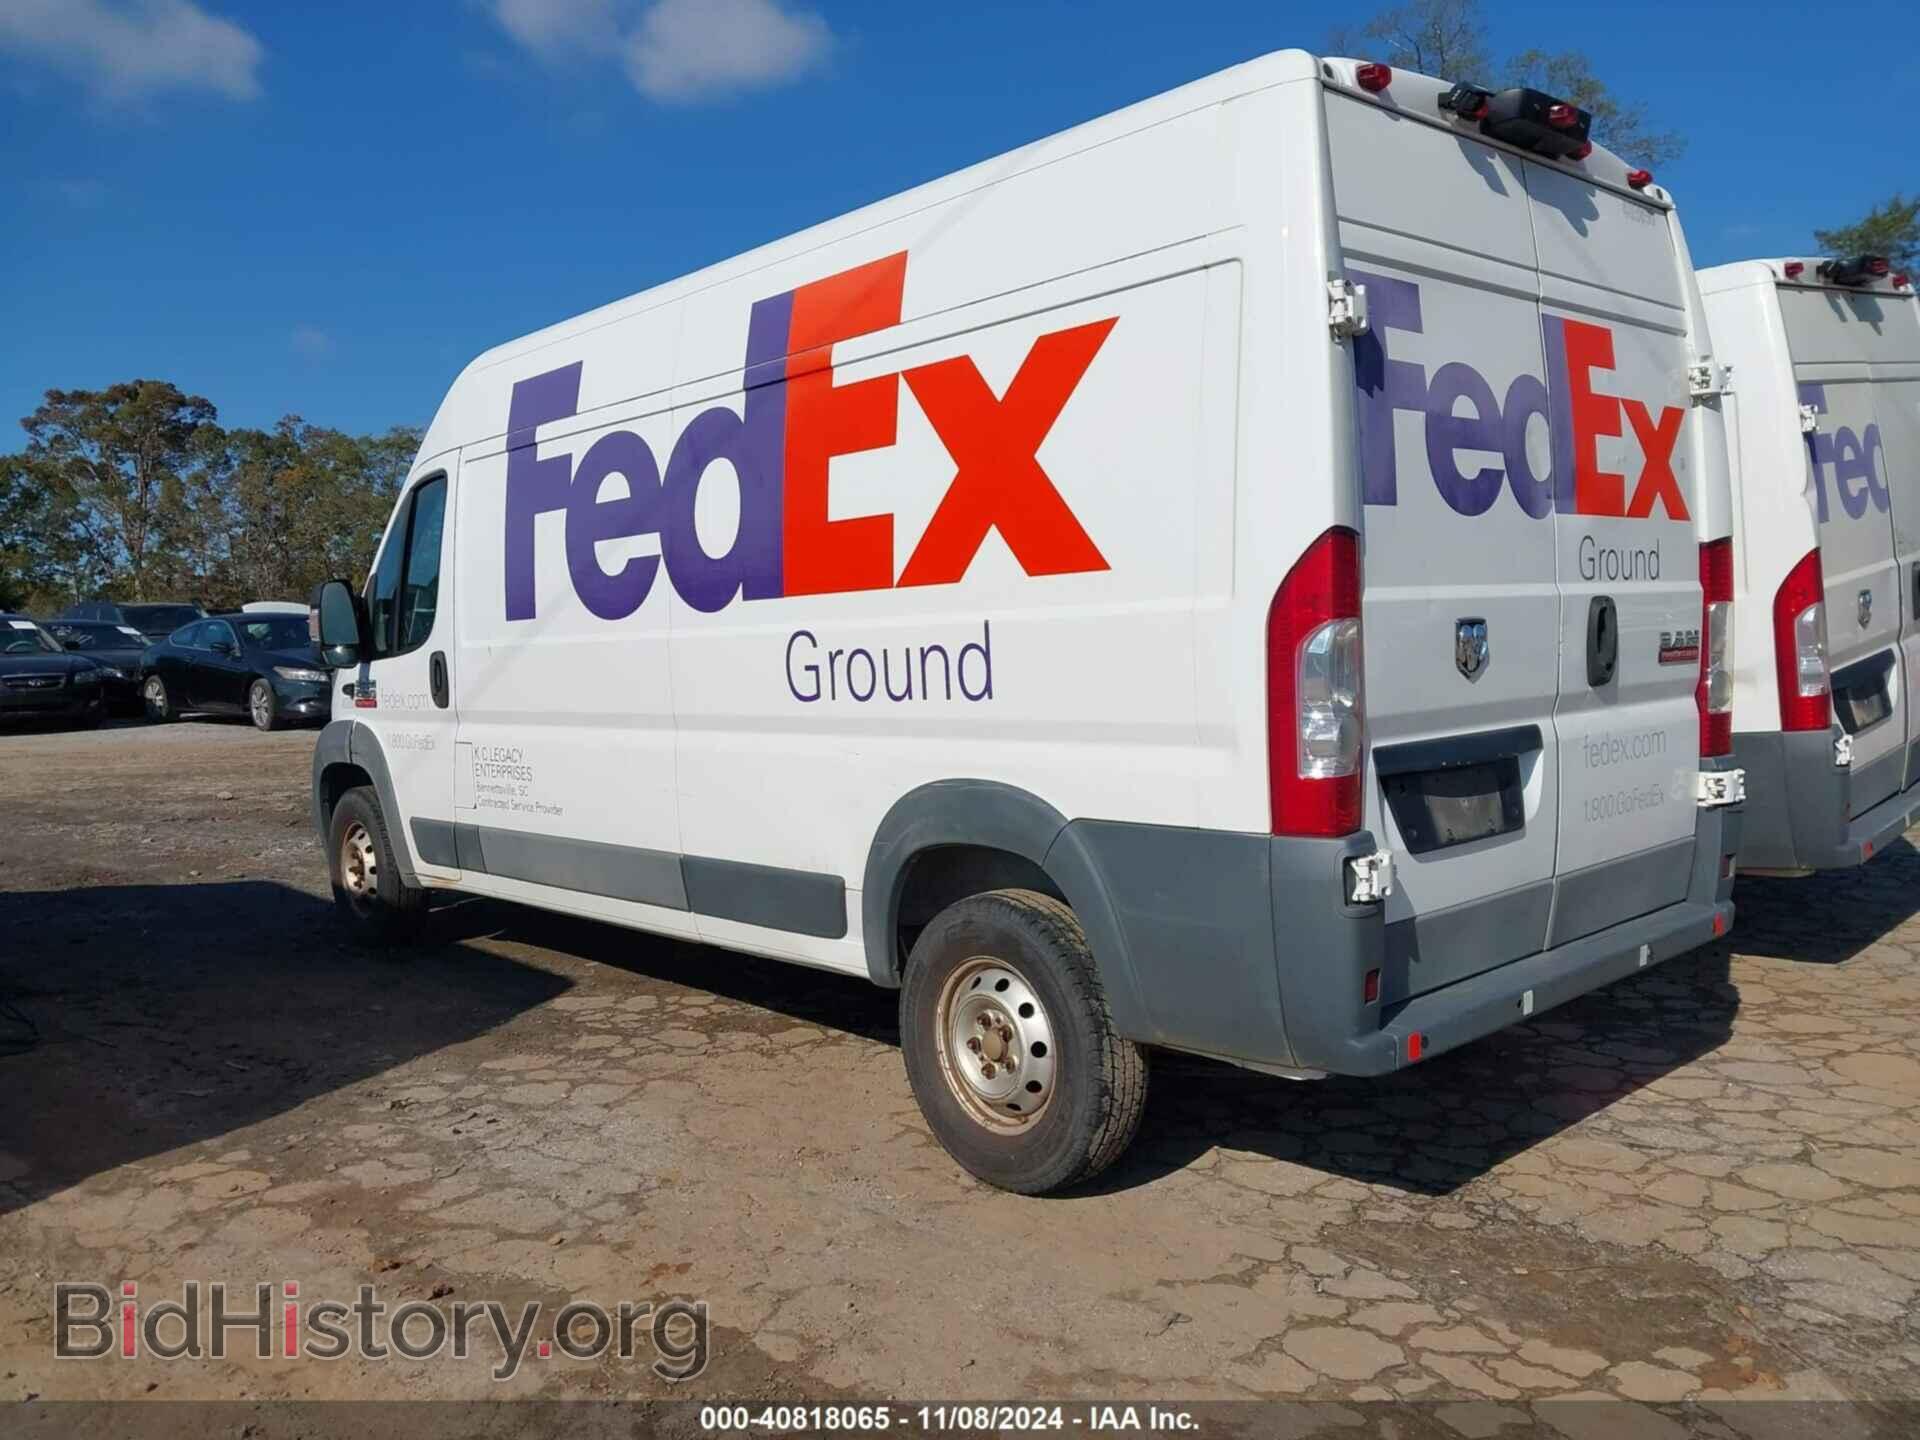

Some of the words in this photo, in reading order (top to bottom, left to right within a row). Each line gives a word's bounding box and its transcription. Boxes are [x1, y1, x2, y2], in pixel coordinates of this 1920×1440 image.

[1344, 267, 1691, 521] FedEx
[504, 249, 1120, 622] FedEx
[1578, 535, 1660, 581] Ground
[786, 620, 994, 703] Ground
[490, 748, 524, 764] LEGACY
[1584, 730, 1666, 768] fedex.com
[475, 763, 533, 782] ENTERPRISES
